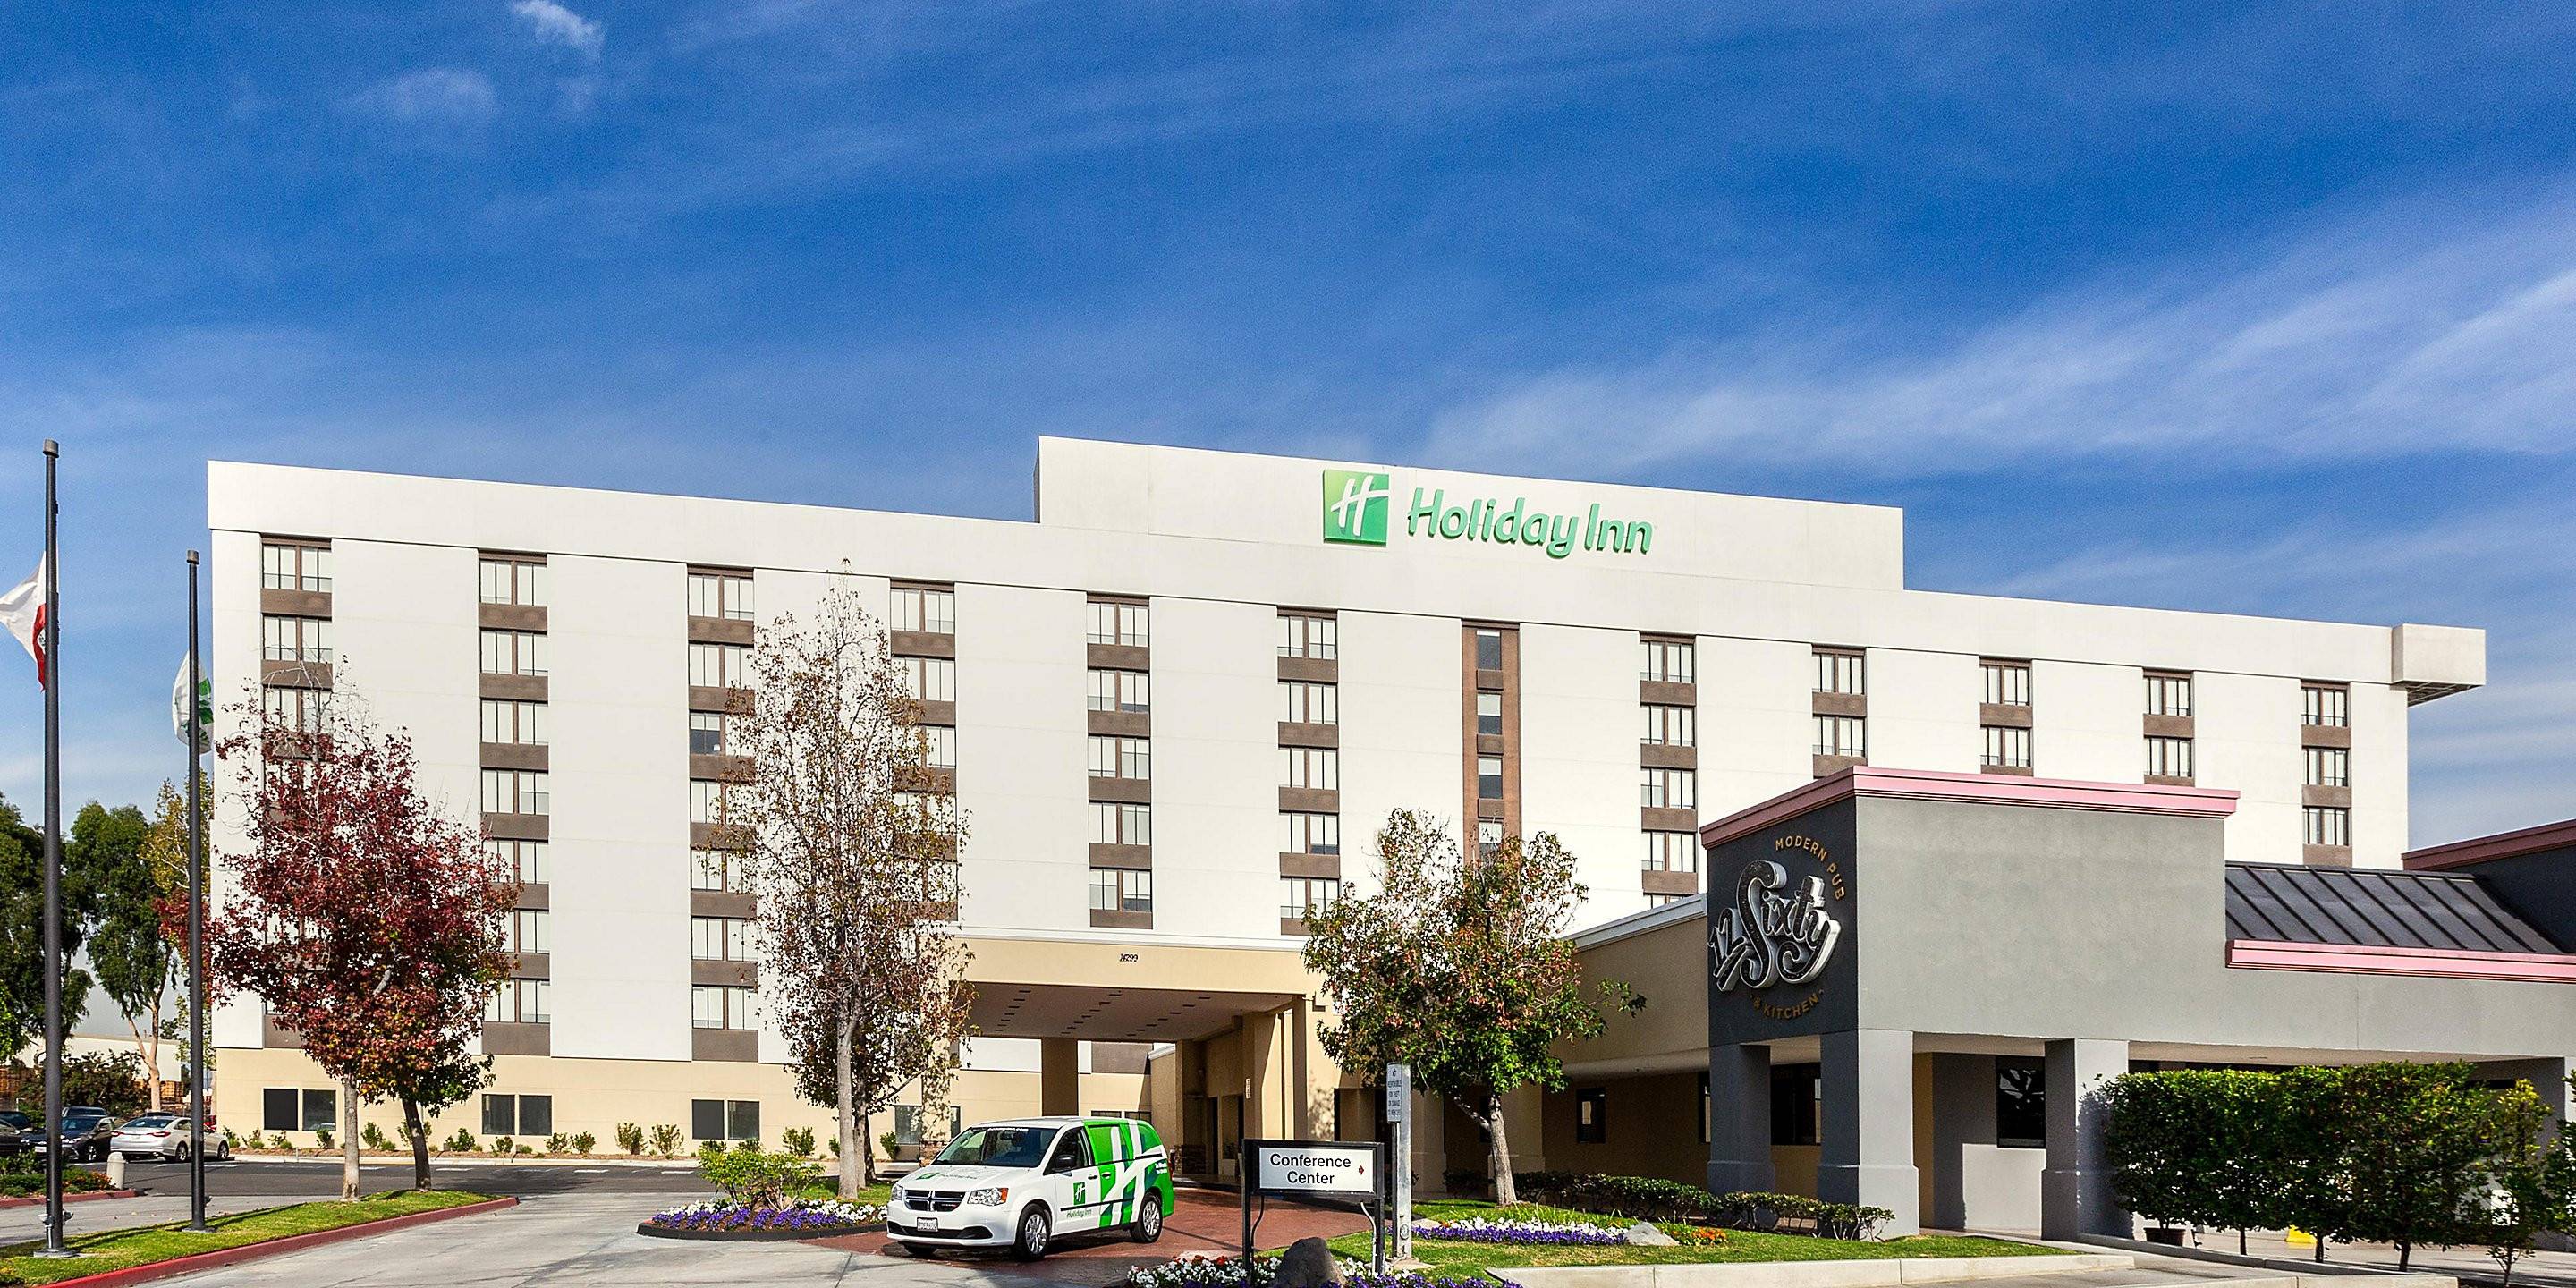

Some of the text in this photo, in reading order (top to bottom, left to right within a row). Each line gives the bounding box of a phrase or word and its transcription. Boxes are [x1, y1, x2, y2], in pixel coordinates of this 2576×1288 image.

[1408, 487, 1654, 558] Holiday Inn
[1775, 835, 1846, 901] MODERN PUB
[1736, 860, 1843, 989] Sixty
[1763, 992, 1819, 1019] KITCHEN
[1270, 1153, 1352, 1168] Conference
[1287, 1171, 1335, 1184] Center
[1066, 1210, 1084, 1218] Holiday
